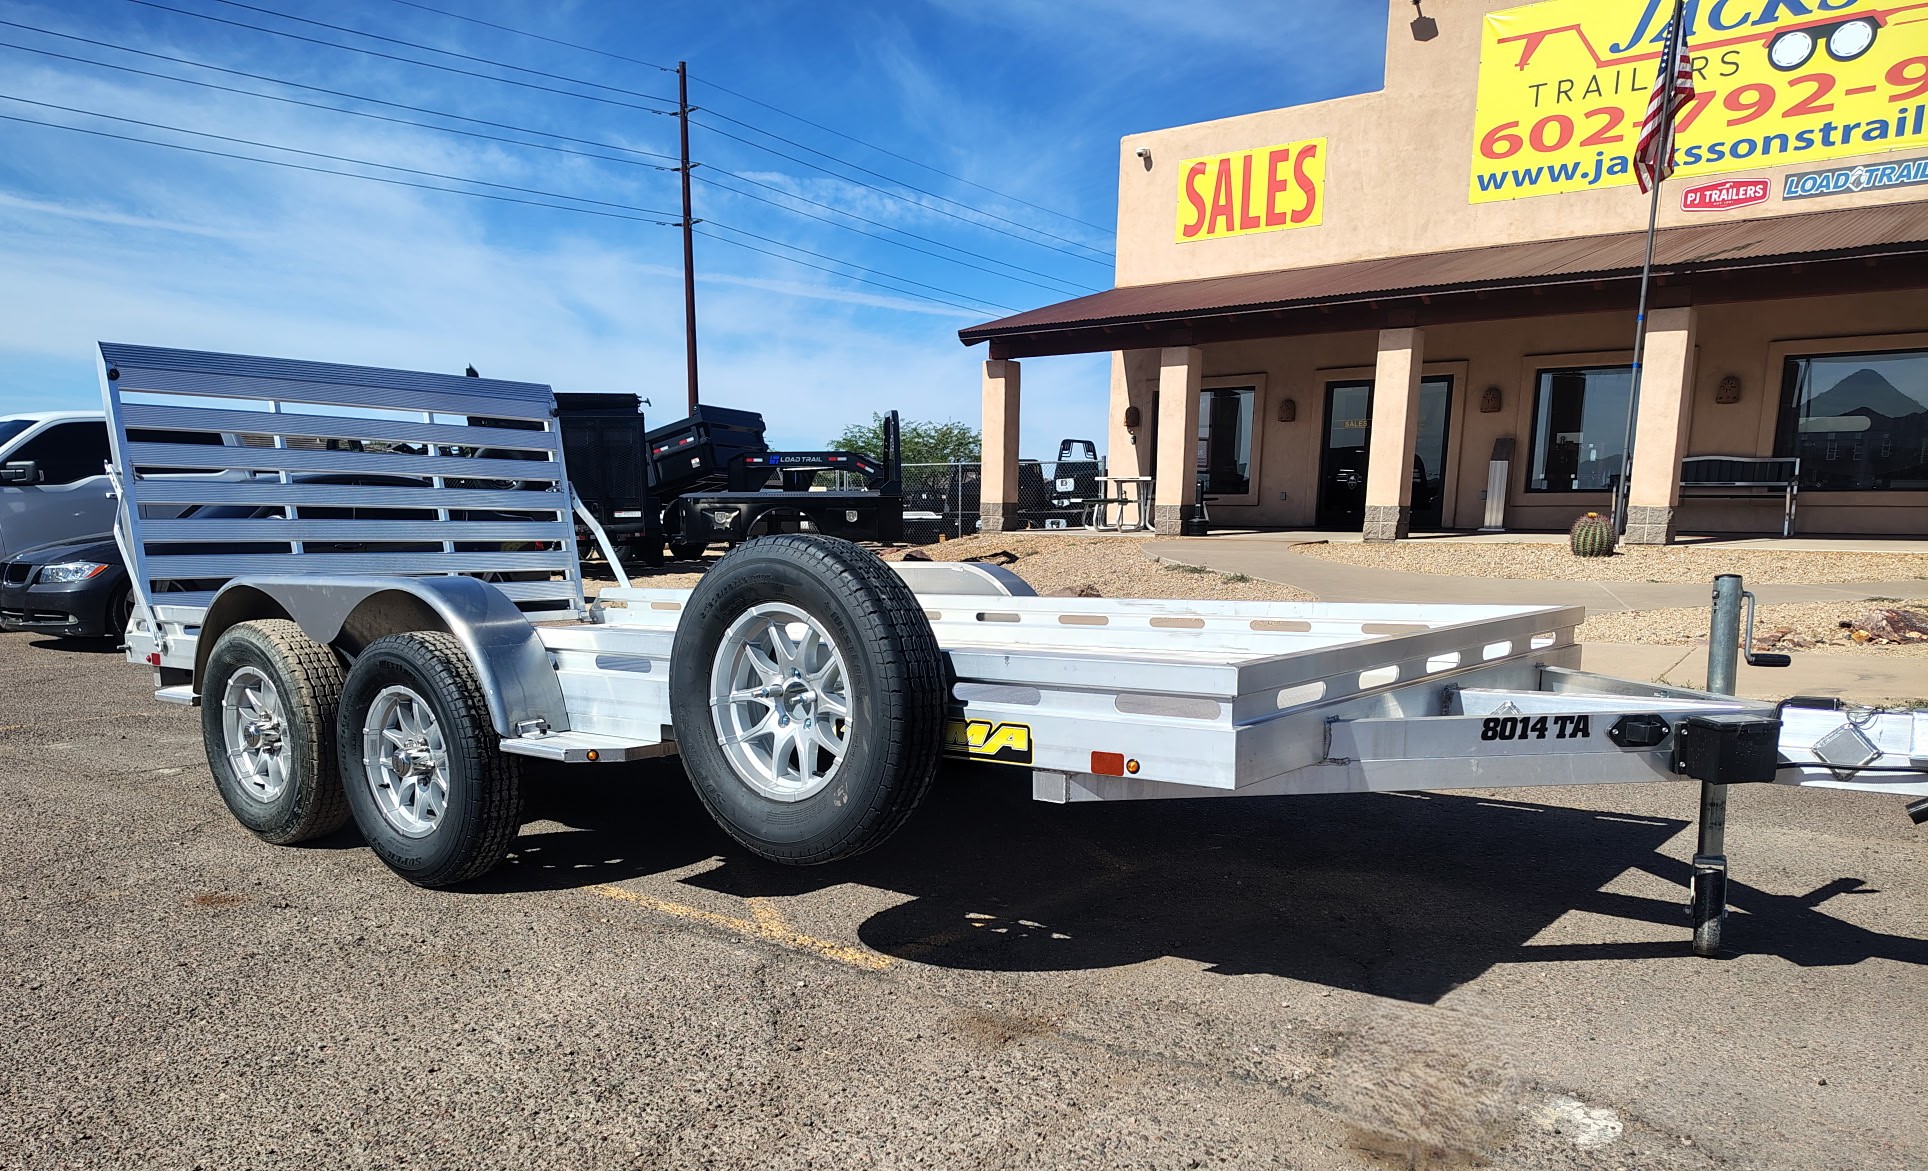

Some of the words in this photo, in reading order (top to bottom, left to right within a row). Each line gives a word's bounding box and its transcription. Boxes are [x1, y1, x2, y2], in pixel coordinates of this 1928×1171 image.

[1528, 50, 1740, 107] TRAILRS
[1477, 104, 1926, 191] www.jassonstrail
[1183, 144, 1318, 238] SALES
[1686, 191, 1701, 205] PJ
[1704, 184, 1764, 203] TRAILERS
[1784, 171, 1852, 198] LOAD
[1344, 420, 1368, 428] SALES
[1481, 715, 1548, 741] 8014
[1553, 714, 1590, 739] TA
